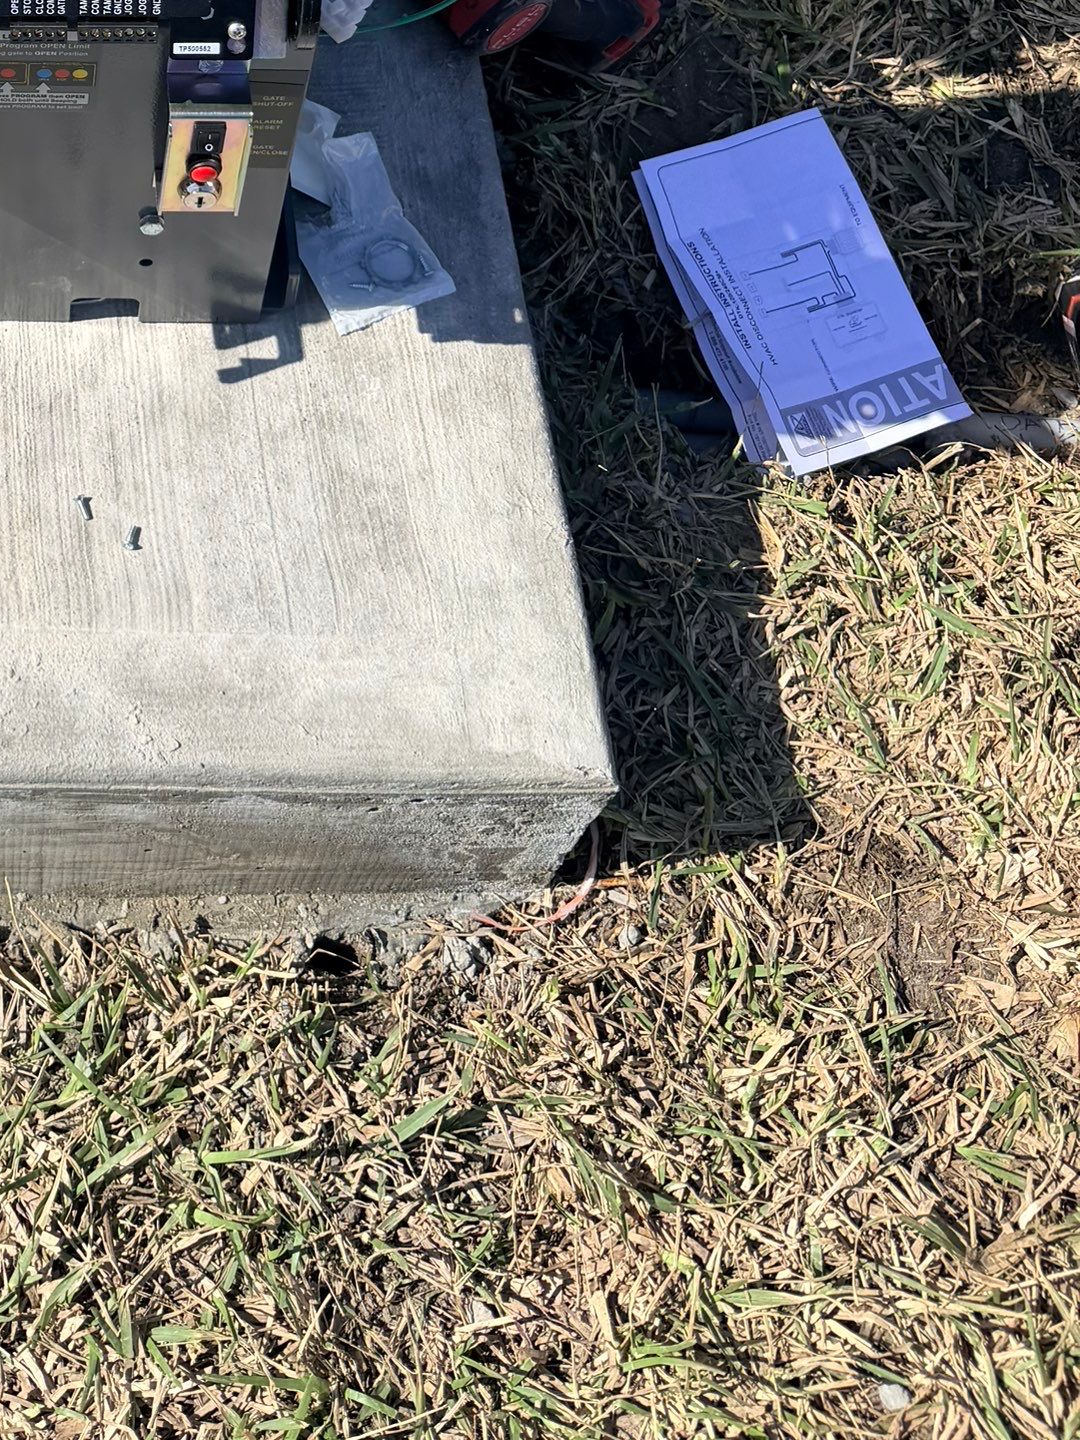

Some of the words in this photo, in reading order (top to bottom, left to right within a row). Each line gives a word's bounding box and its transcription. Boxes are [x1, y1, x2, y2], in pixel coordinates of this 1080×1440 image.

[686, 240, 730, 308] INSTRUCTIONS
[726, 309, 752, 350] INSTALL
[732, 284, 764, 340] DISCONNECT
[760, 341, 778, 366] HVAC
